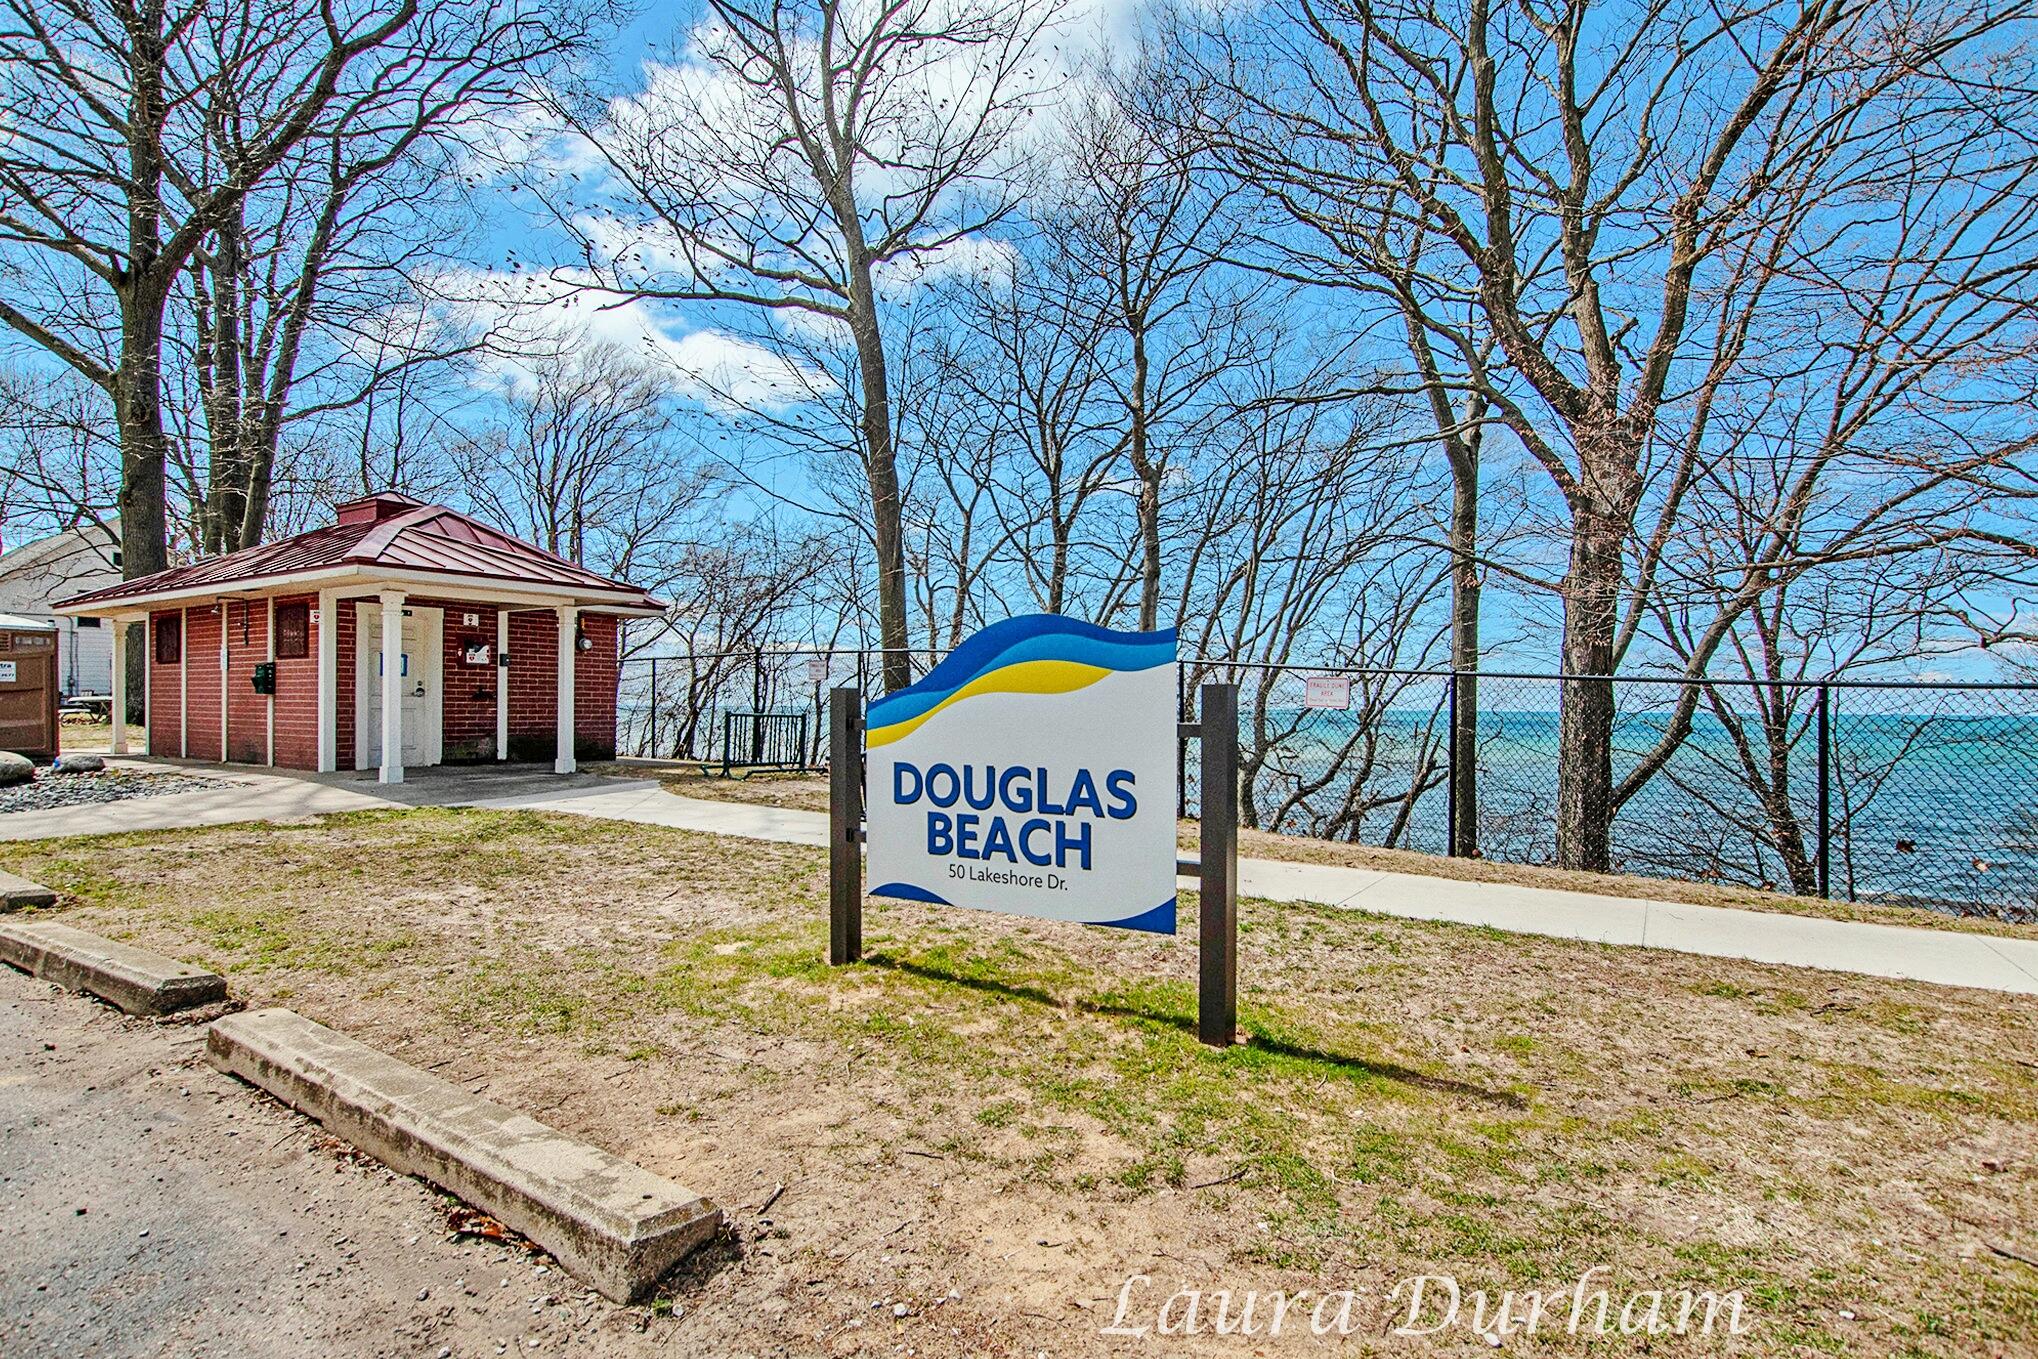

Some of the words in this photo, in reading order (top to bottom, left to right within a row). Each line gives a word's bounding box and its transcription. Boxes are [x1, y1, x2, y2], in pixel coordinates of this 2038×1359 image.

[893, 761, 1138, 820] DOUGLAS
[927, 811, 1092, 871] BEACH
[949, 864, 966, 880] 50
[969, 866, 1043, 888] Lakeshore
[1047, 874, 1069, 892] Dr.
